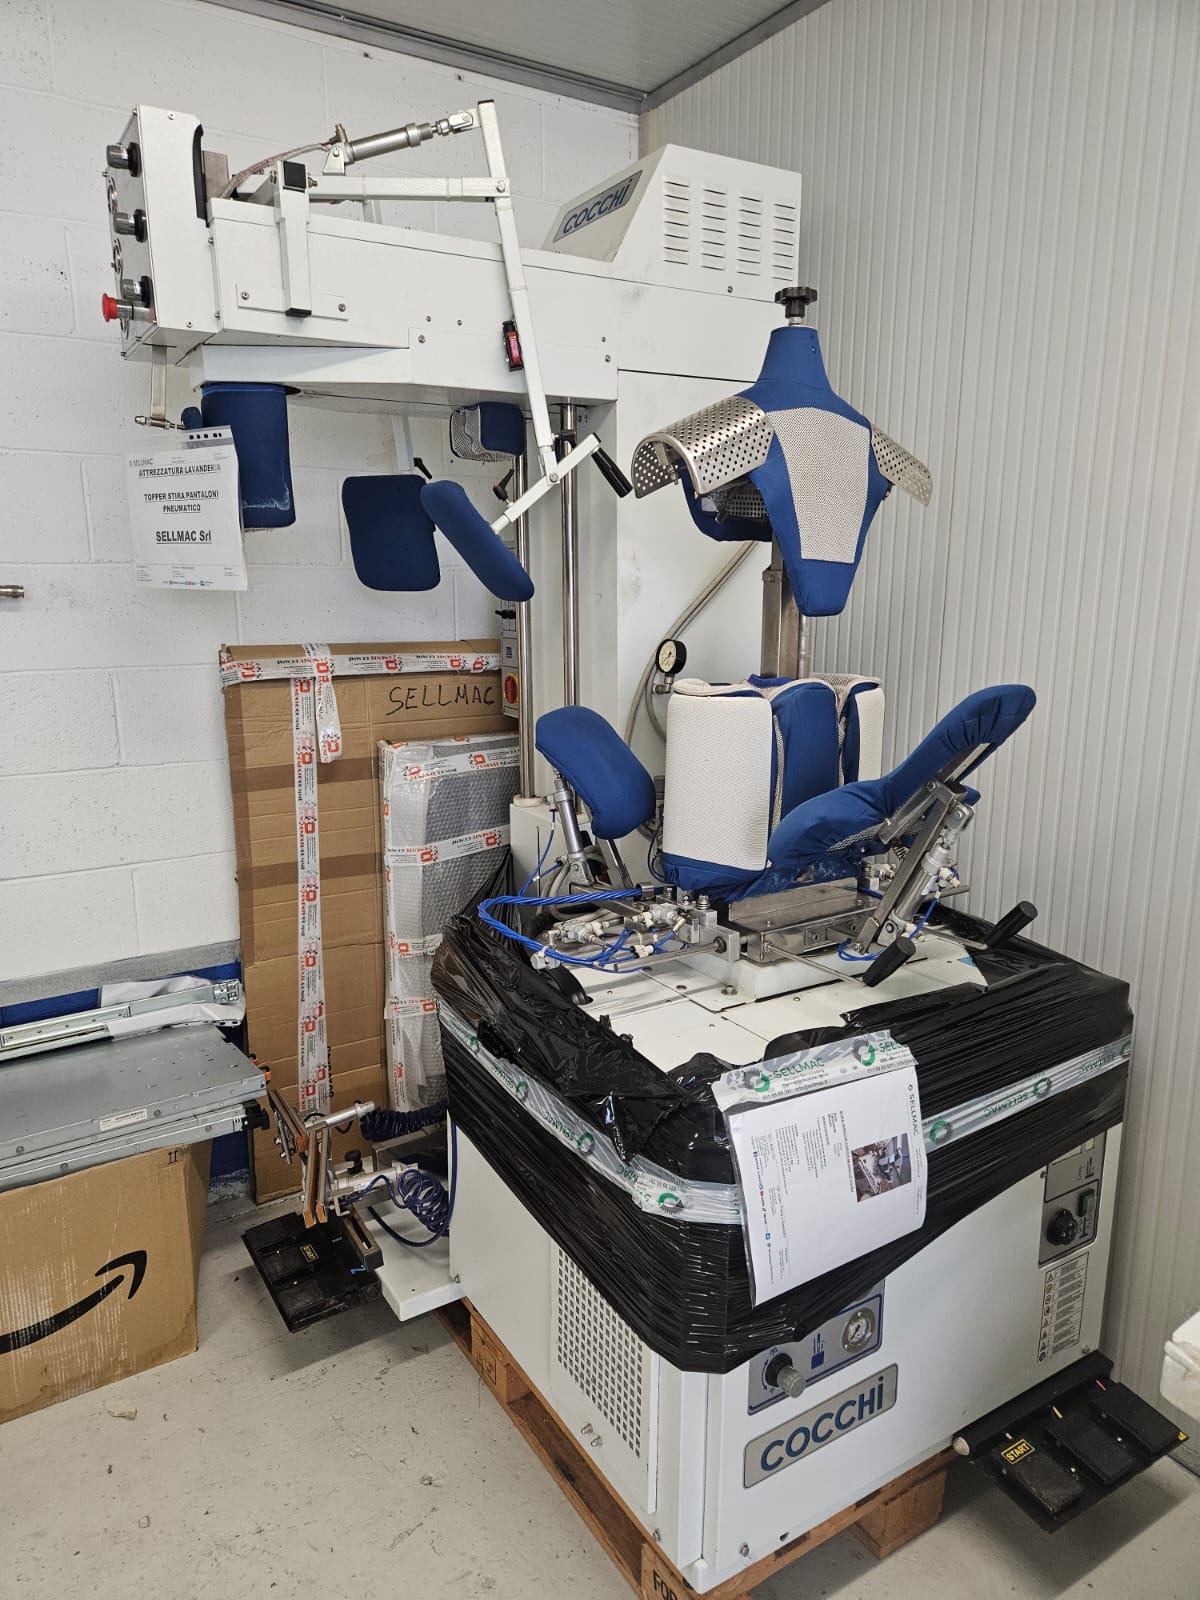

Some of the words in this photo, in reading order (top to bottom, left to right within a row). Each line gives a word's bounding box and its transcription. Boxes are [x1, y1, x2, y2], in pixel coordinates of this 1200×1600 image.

[139, 466, 184, 477] ATTREZZATURA
[167, 491, 185, 501] STIRA
[185, 489, 219, 500] PANTALONI
[162, 503, 202, 513] PNEUMATICO
[155, 530, 197, 543] SELLMAC
[199, 529, 212, 542] Srl
[385, 683, 495, 716] SELLMAC
[774, 1058, 825, 1080] SELLMAC
[908, 1093, 920, 1137] SELLMAC
[1005, 1441, 1031, 1462] START
